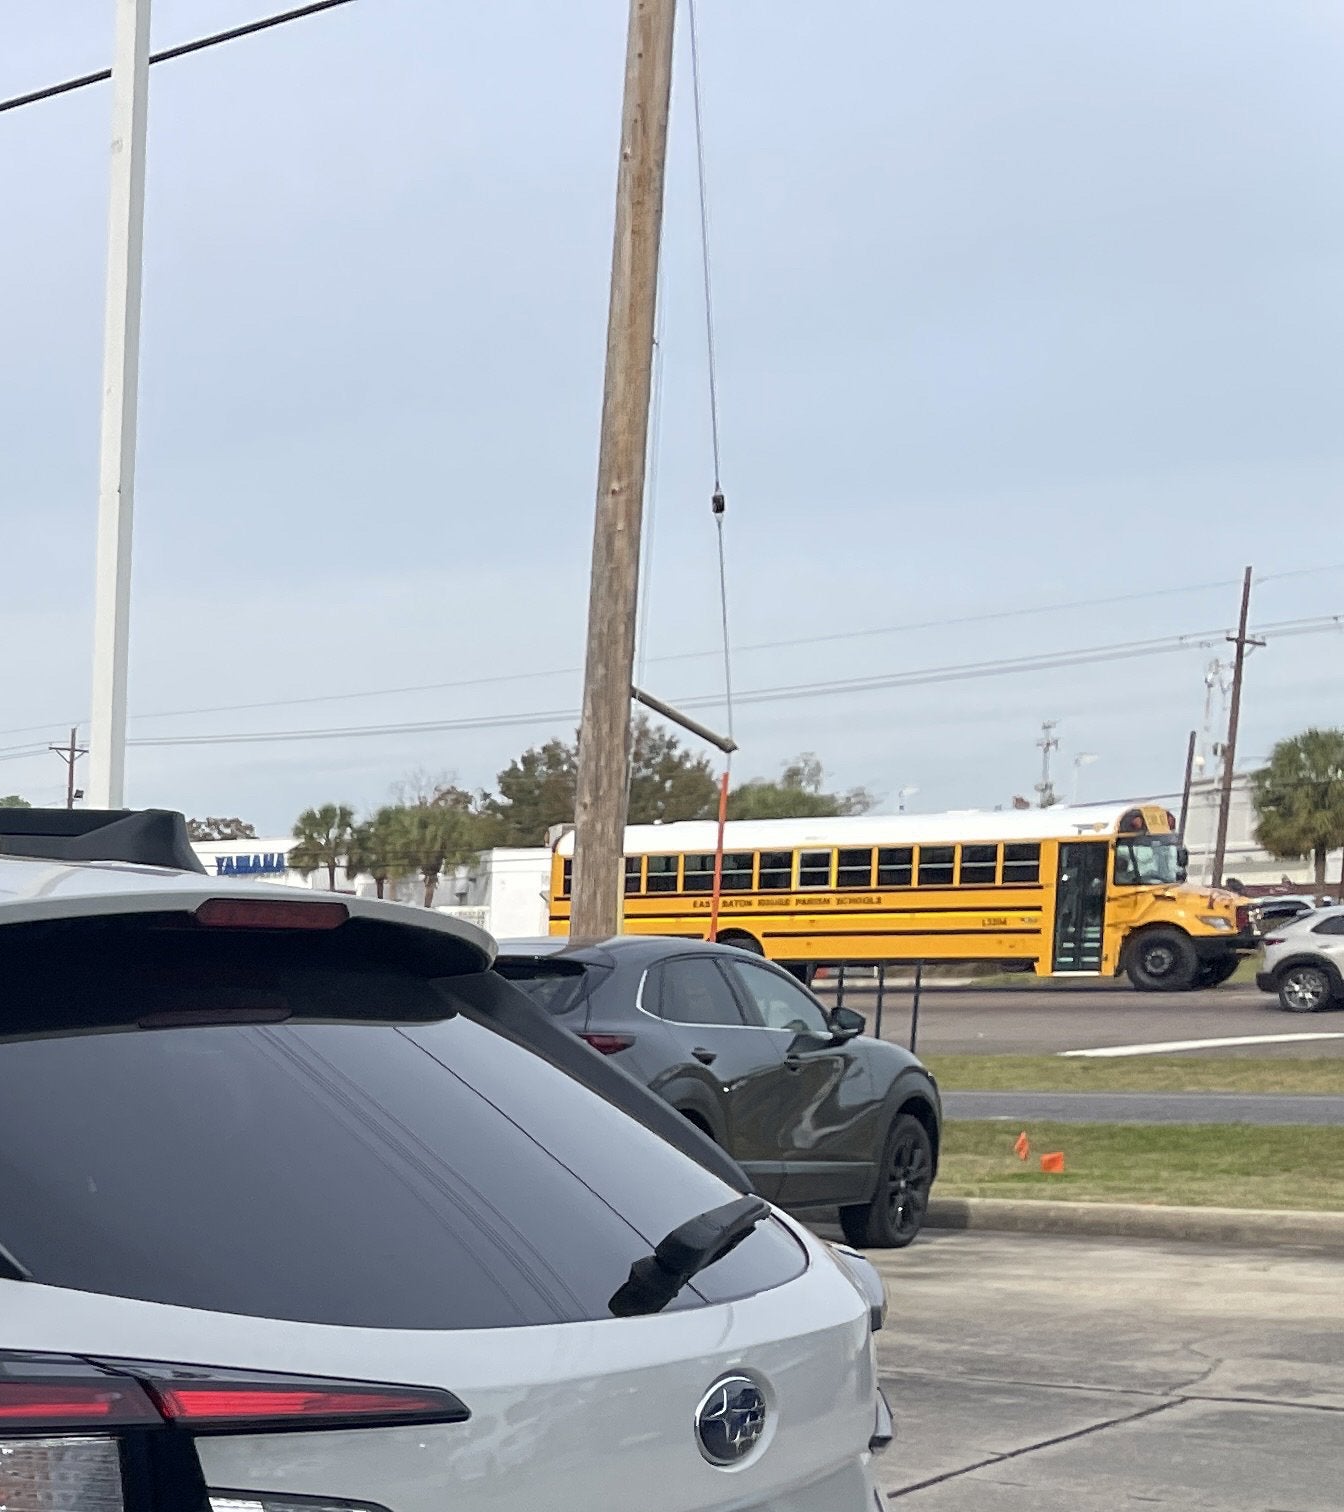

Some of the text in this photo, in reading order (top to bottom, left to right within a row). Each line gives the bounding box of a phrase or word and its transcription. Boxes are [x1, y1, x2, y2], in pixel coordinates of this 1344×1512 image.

[215, 853, 284, 876] YAMAHA
[722, 899, 753, 908] BATON
[836, 896, 882, 905] SCHOOLS
